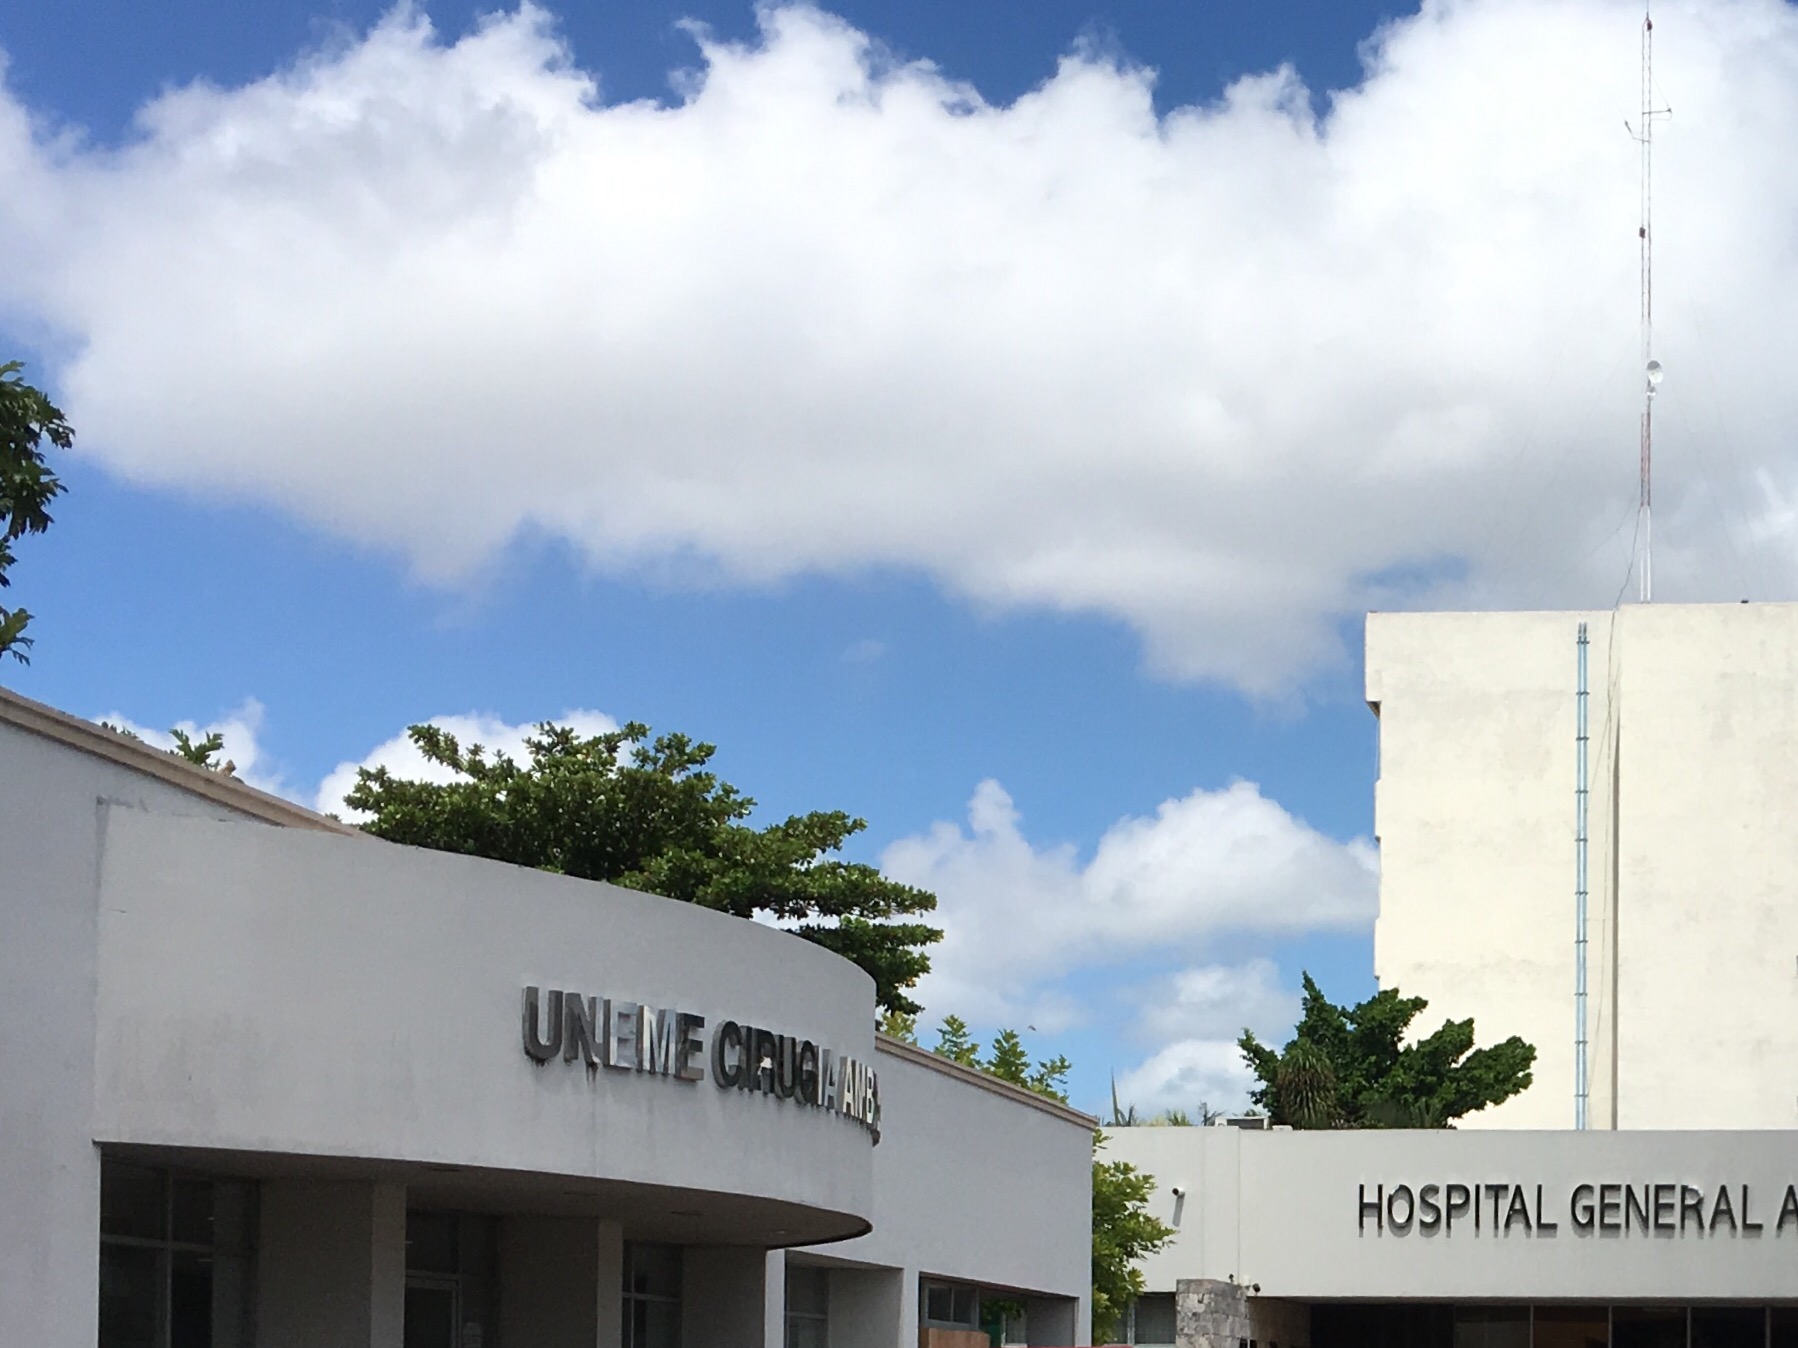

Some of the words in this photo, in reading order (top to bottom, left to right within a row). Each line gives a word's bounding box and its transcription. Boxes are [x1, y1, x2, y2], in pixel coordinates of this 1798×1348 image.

[522, 985, 706, 1082] UNEME
[1357, 1182, 1558, 1232] HOSPITAL
[1570, 1182, 1764, 1232] GENERAL
